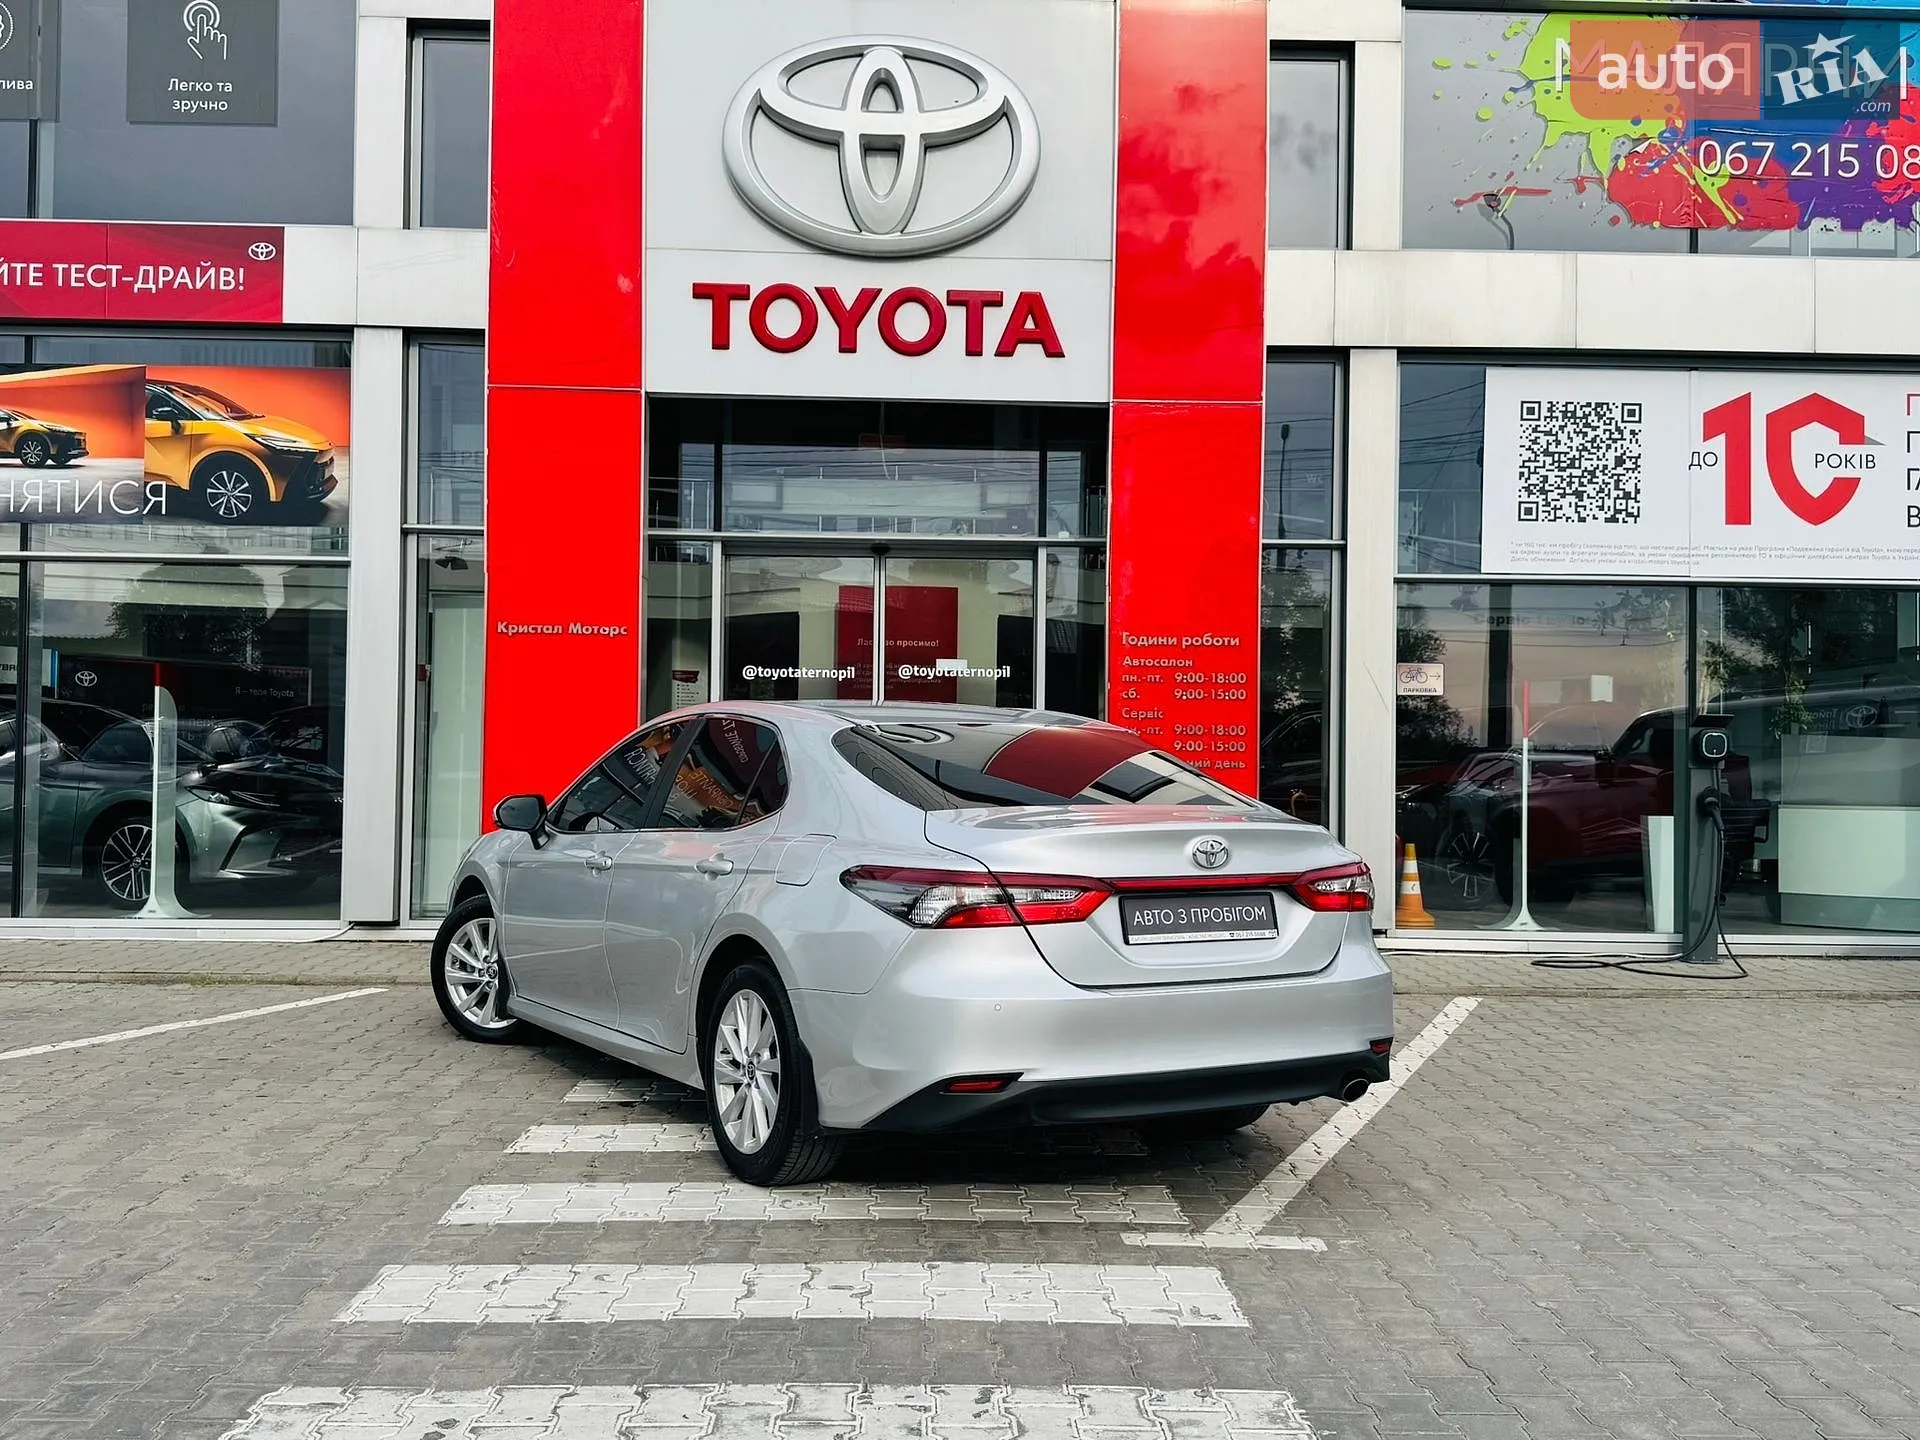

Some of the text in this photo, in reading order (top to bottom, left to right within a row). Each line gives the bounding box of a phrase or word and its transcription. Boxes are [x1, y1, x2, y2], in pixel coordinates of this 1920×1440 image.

[167, 78, 233, 92] Легко та
[172, 100, 228, 113] зручно
[1699, 140, 1920, 180] 067 215 08
[54, 261, 245, 293] ТЕСТ-ДРАЙВ!
[692, 282, 1066, 359] TOYOTA
[1688, 451, 1719, 471] ДО
[1814, 452, 1877, 470] РОКІВ
[497, 621, 628, 637] Кристал Моторс
[896, 639, 940, 648] просимо!
[1121, 632, 1240, 648] Години роботи
[1122, 656, 1193, 667] Автосалон
[741, 664, 855, 682] @toyotaternopil
[898, 663, 1011, 681] @toyotaternopil
[1121, 673, 1164, 683] пн.-пт.
[270, 687, 295, 699] Toyota
[1121, 687, 1141, 699] сб.
[1121, 707, 1164, 720] Сервіс
[1214, 759, 1246, 770] день
[1133, 906, 1267, 927] АВТО З ПРОБІГОМ
